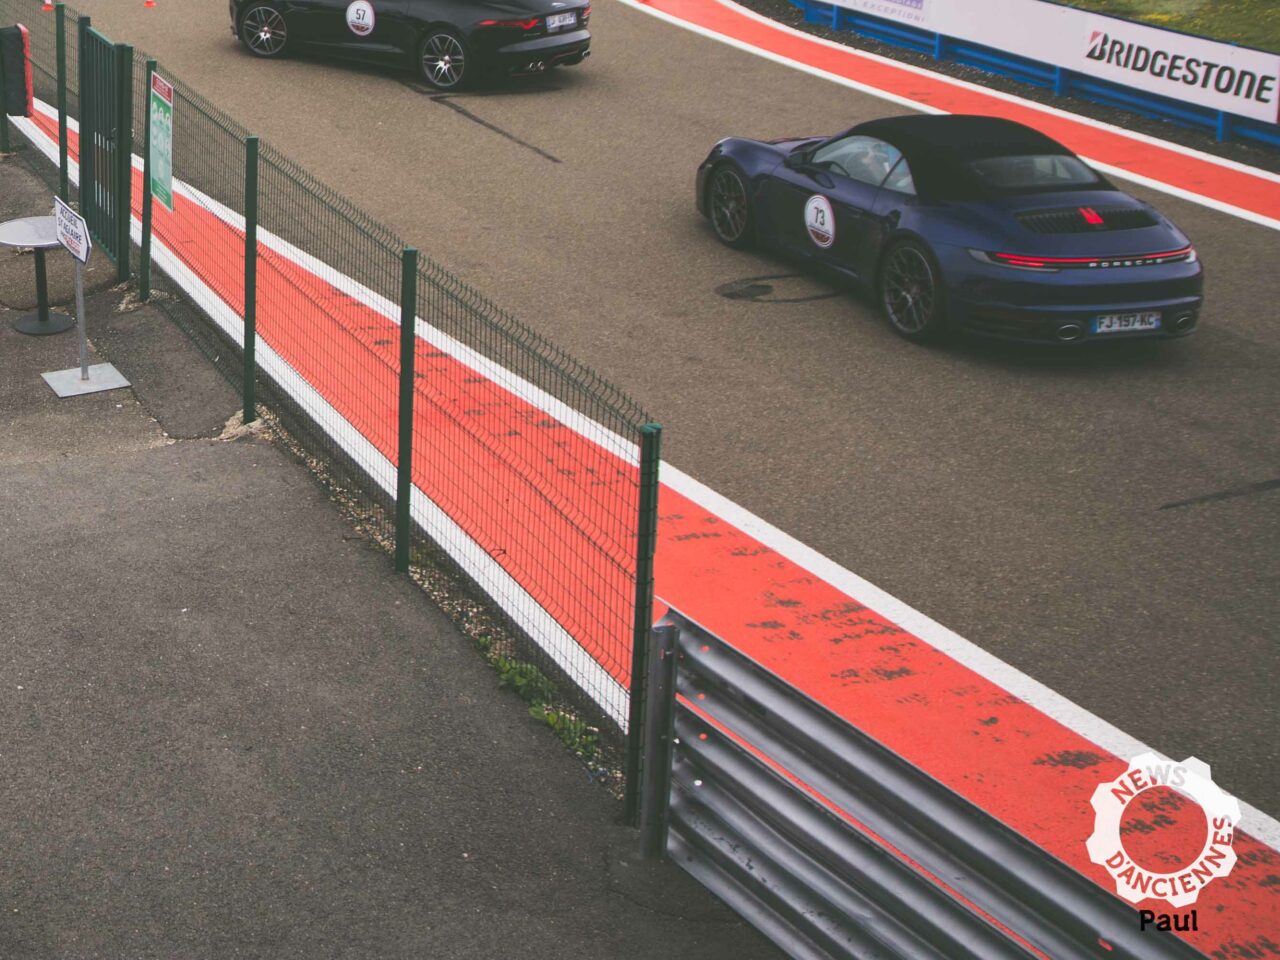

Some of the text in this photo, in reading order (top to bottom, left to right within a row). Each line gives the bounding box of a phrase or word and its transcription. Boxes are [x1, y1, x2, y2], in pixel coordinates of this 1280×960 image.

[355, 8, 366, 21] 57
[1086, 31, 1276, 103] BRIDGESTONE
[814, 206, 825, 226] 73
